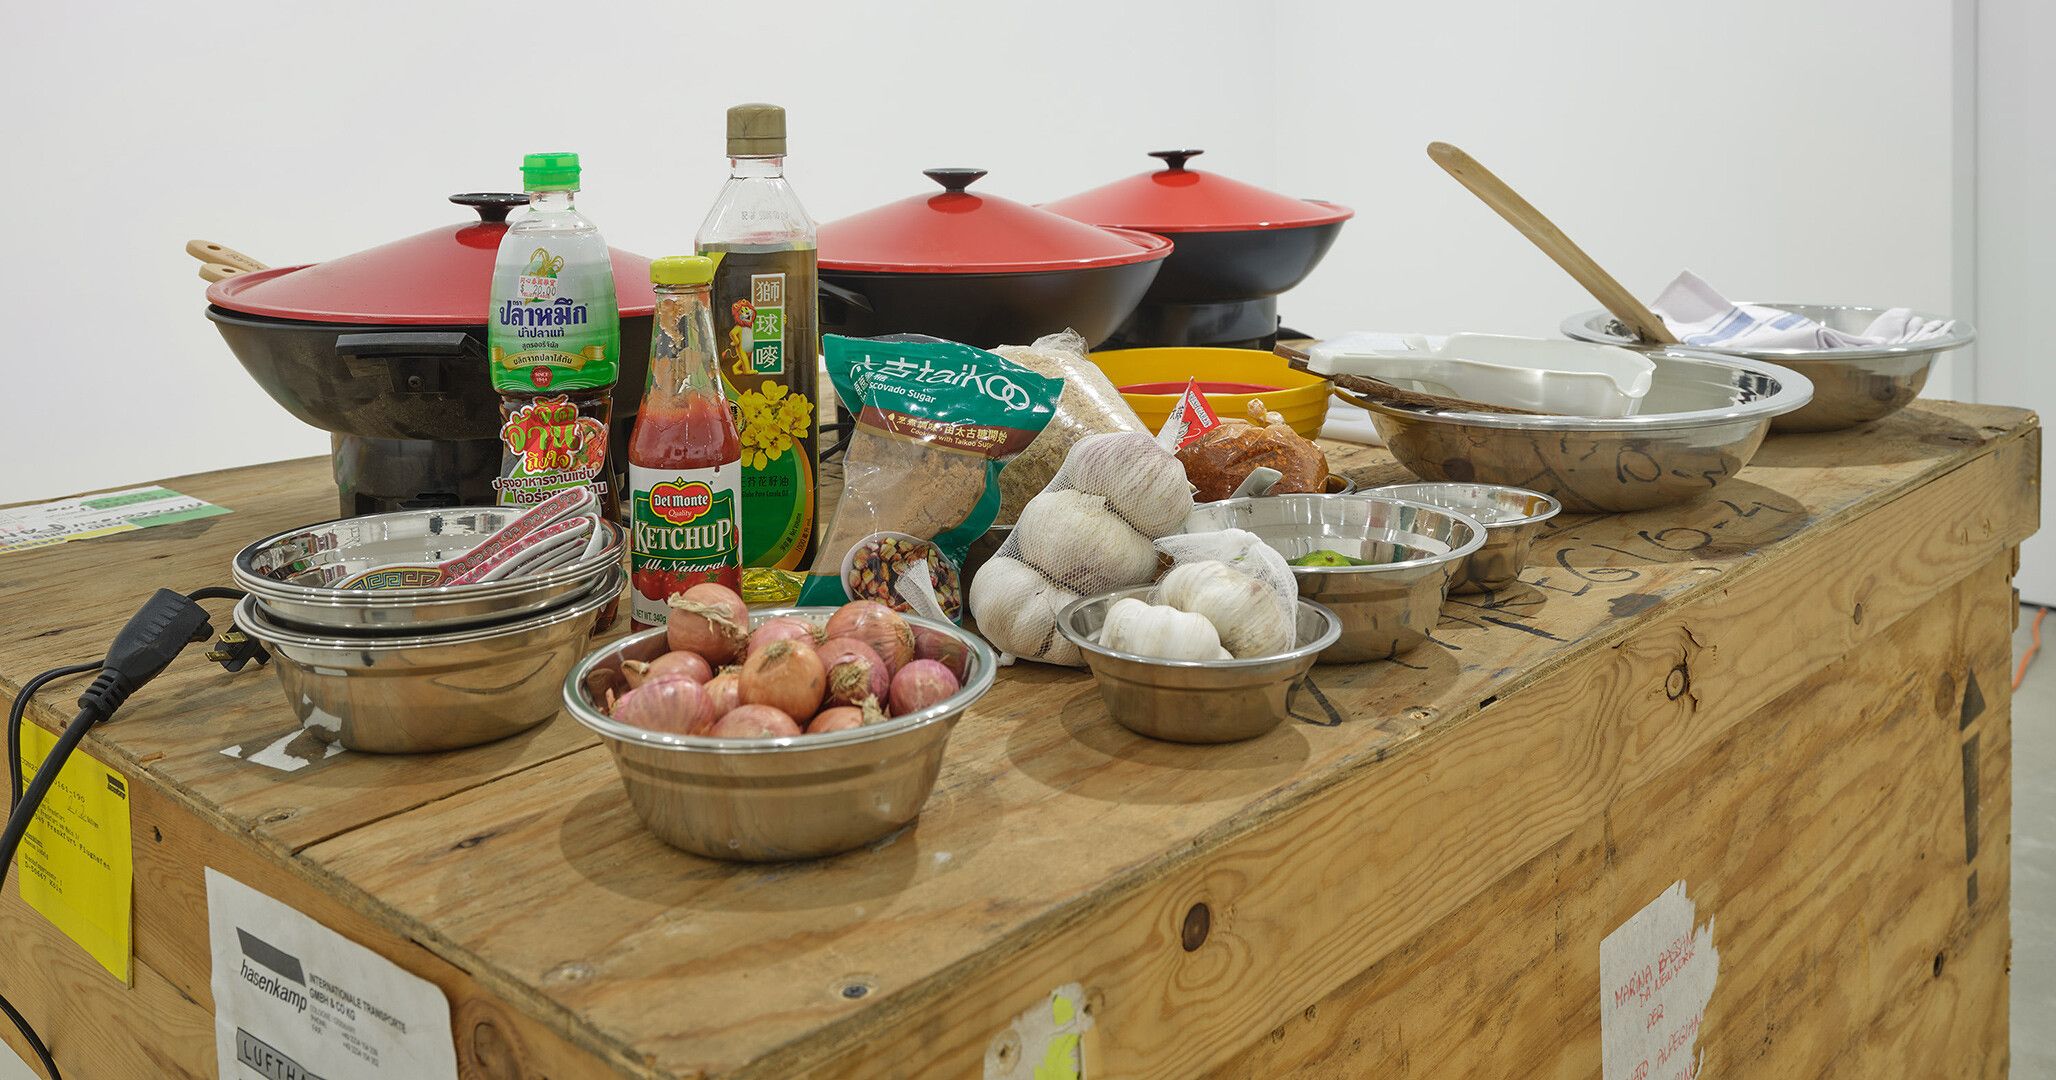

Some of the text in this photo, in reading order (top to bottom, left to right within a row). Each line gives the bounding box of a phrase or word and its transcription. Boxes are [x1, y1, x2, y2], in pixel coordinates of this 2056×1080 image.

[533, 285, 557, 297] 20.00
[500, 297, 588, 327] ปลาหมึก
[517, 326, 565, 338] น้ำปลาแท้
[756, 280, 781, 369] 獅球嘜
[907, 389, 937, 404] Sugar
[938, 434, 953, 444] with
[954, 437, 977, 448] Taikoo
[654, 493, 709, 507] Del Monte
[668, 509, 692, 518] Quality
[635, 519, 731, 554] KETCHUP
[638, 555, 727, 574] All Natural
[240, 959, 308, 1014] hasenkamp
[309, 972, 407, 1034] INTERNATIONALE TRANSPORTE
